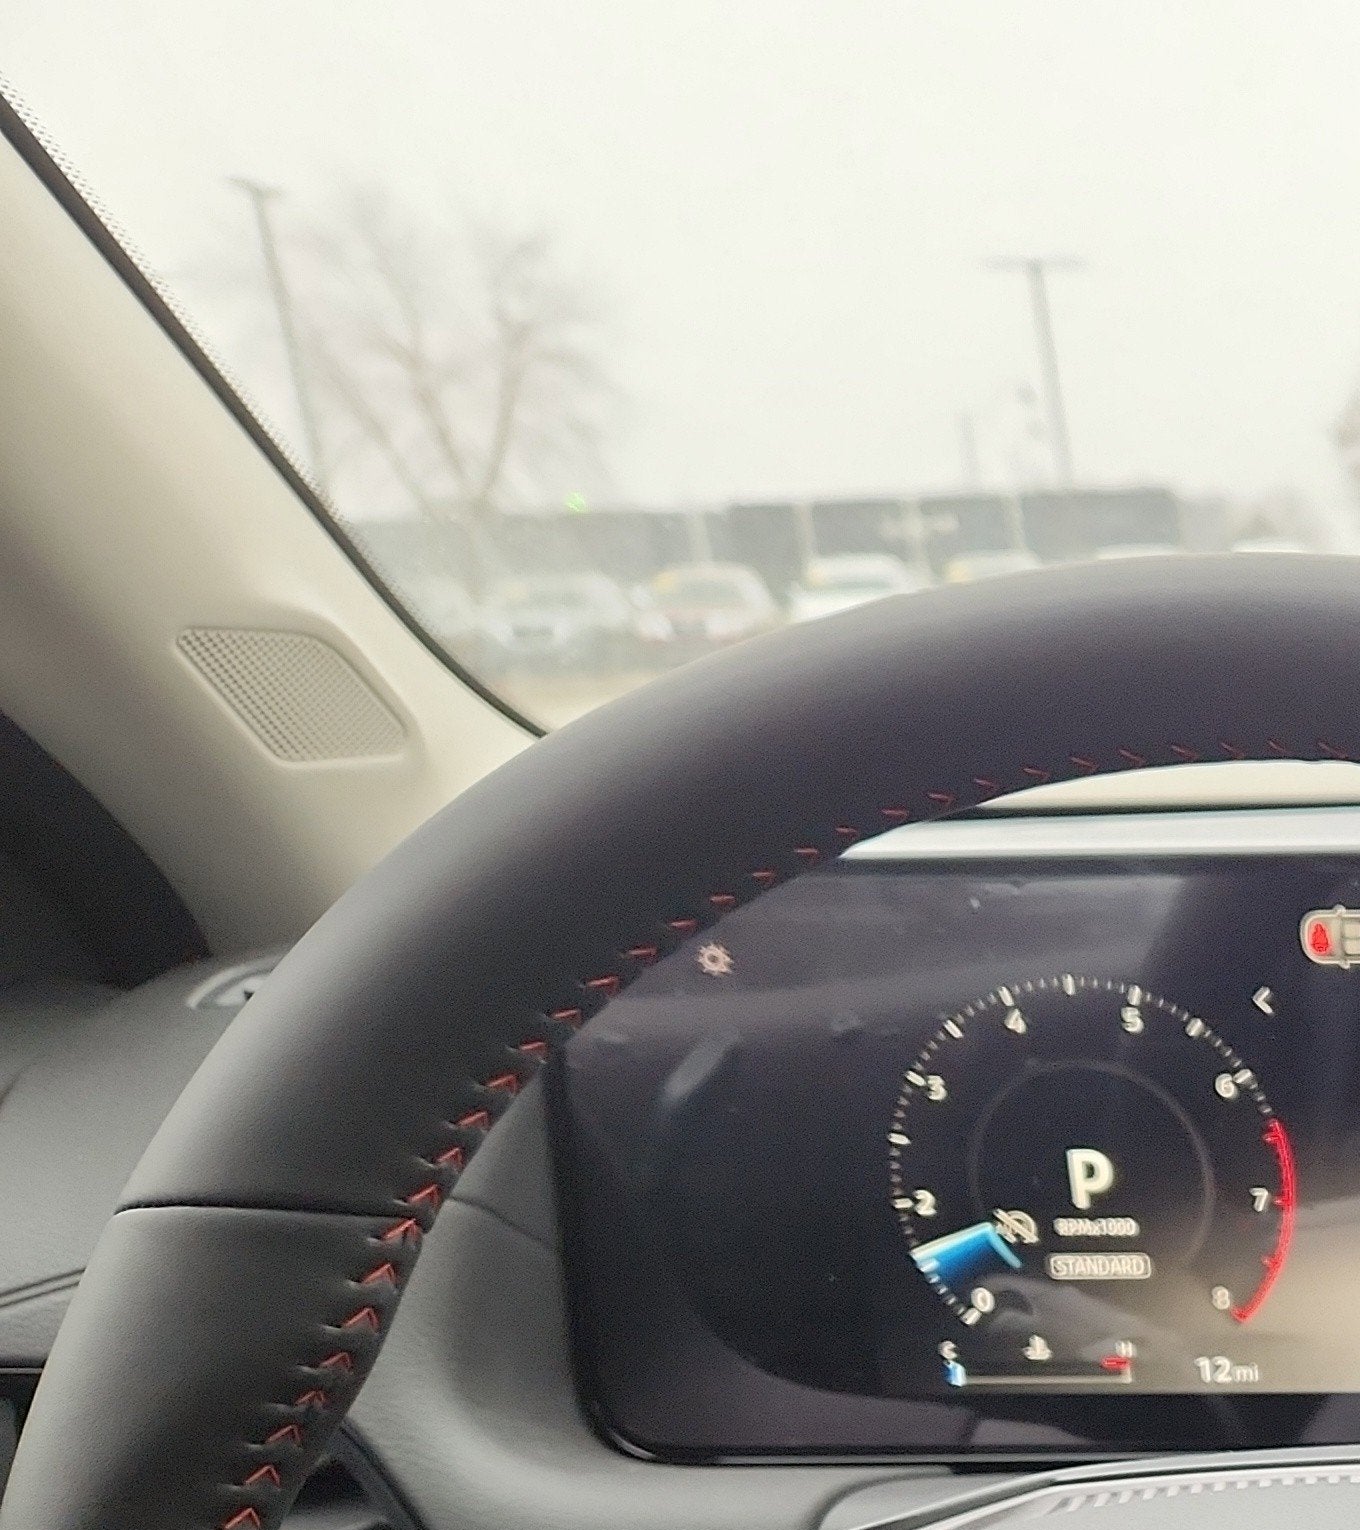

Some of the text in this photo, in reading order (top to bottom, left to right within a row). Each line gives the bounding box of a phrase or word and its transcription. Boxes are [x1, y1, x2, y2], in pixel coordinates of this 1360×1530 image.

[1004, 1008, 1028, 1034] 4
[1120, 1006, 1145, 1034] 5
[926, 1073, 949, 1102] 3
[1214, 1072, 1240, 1100] 6
[1065, 1148, 1114, 1209] P
[913, 1188, 938, 1218] 2
[1249, 1187, 1270, 1213] 7
[1052, 1254, 1146, 1276] STANDARD
[970, 1286, 996, 1313] 0
[1210, 1285, 1232, 1310] 8
